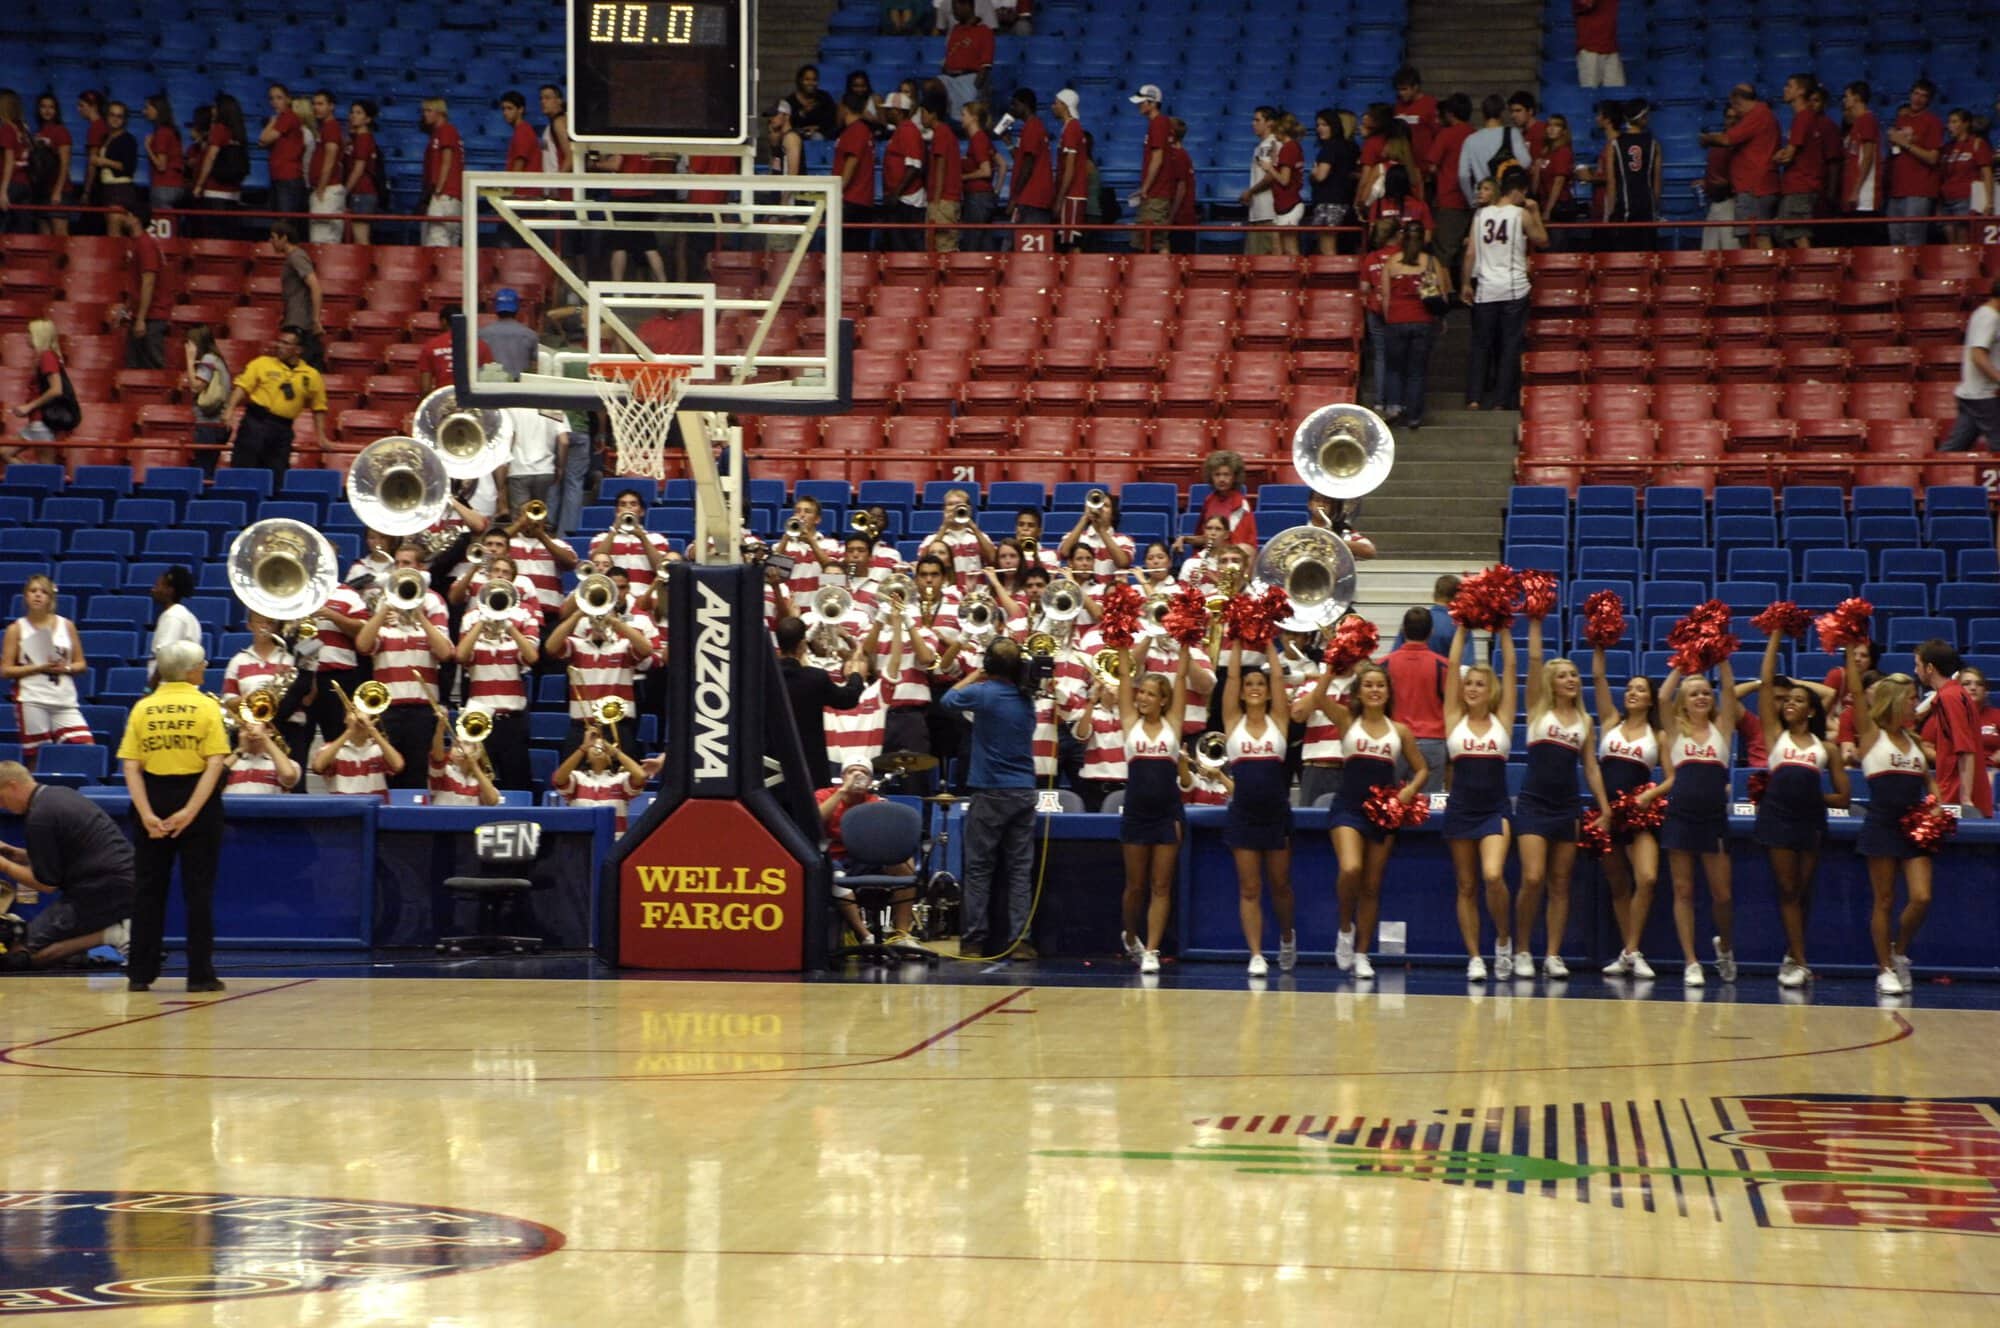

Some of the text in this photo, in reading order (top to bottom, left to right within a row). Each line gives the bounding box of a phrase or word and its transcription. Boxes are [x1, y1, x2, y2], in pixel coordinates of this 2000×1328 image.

[590, 3, 695, 44] 00.0
[1628, 145, 1643, 172] 3
[1022, 234, 1045, 251] 21
[1483, 218, 1509, 245] 34
[1984, 225, 2000, 245] 2
[952, 465, 975, 482] 21
[1982, 469, 2000, 492] 2
[694, 579, 732, 779] ARIZONA
[145, 704, 198, 715] EVENT
[147, 720, 197, 732] STAFF
[142, 735, 202, 753] SECURITY
[474, 822, 541, 858] FSN
[635, 865, 788, 896] WELLS
[640, 901, 785, 932] FARGO
